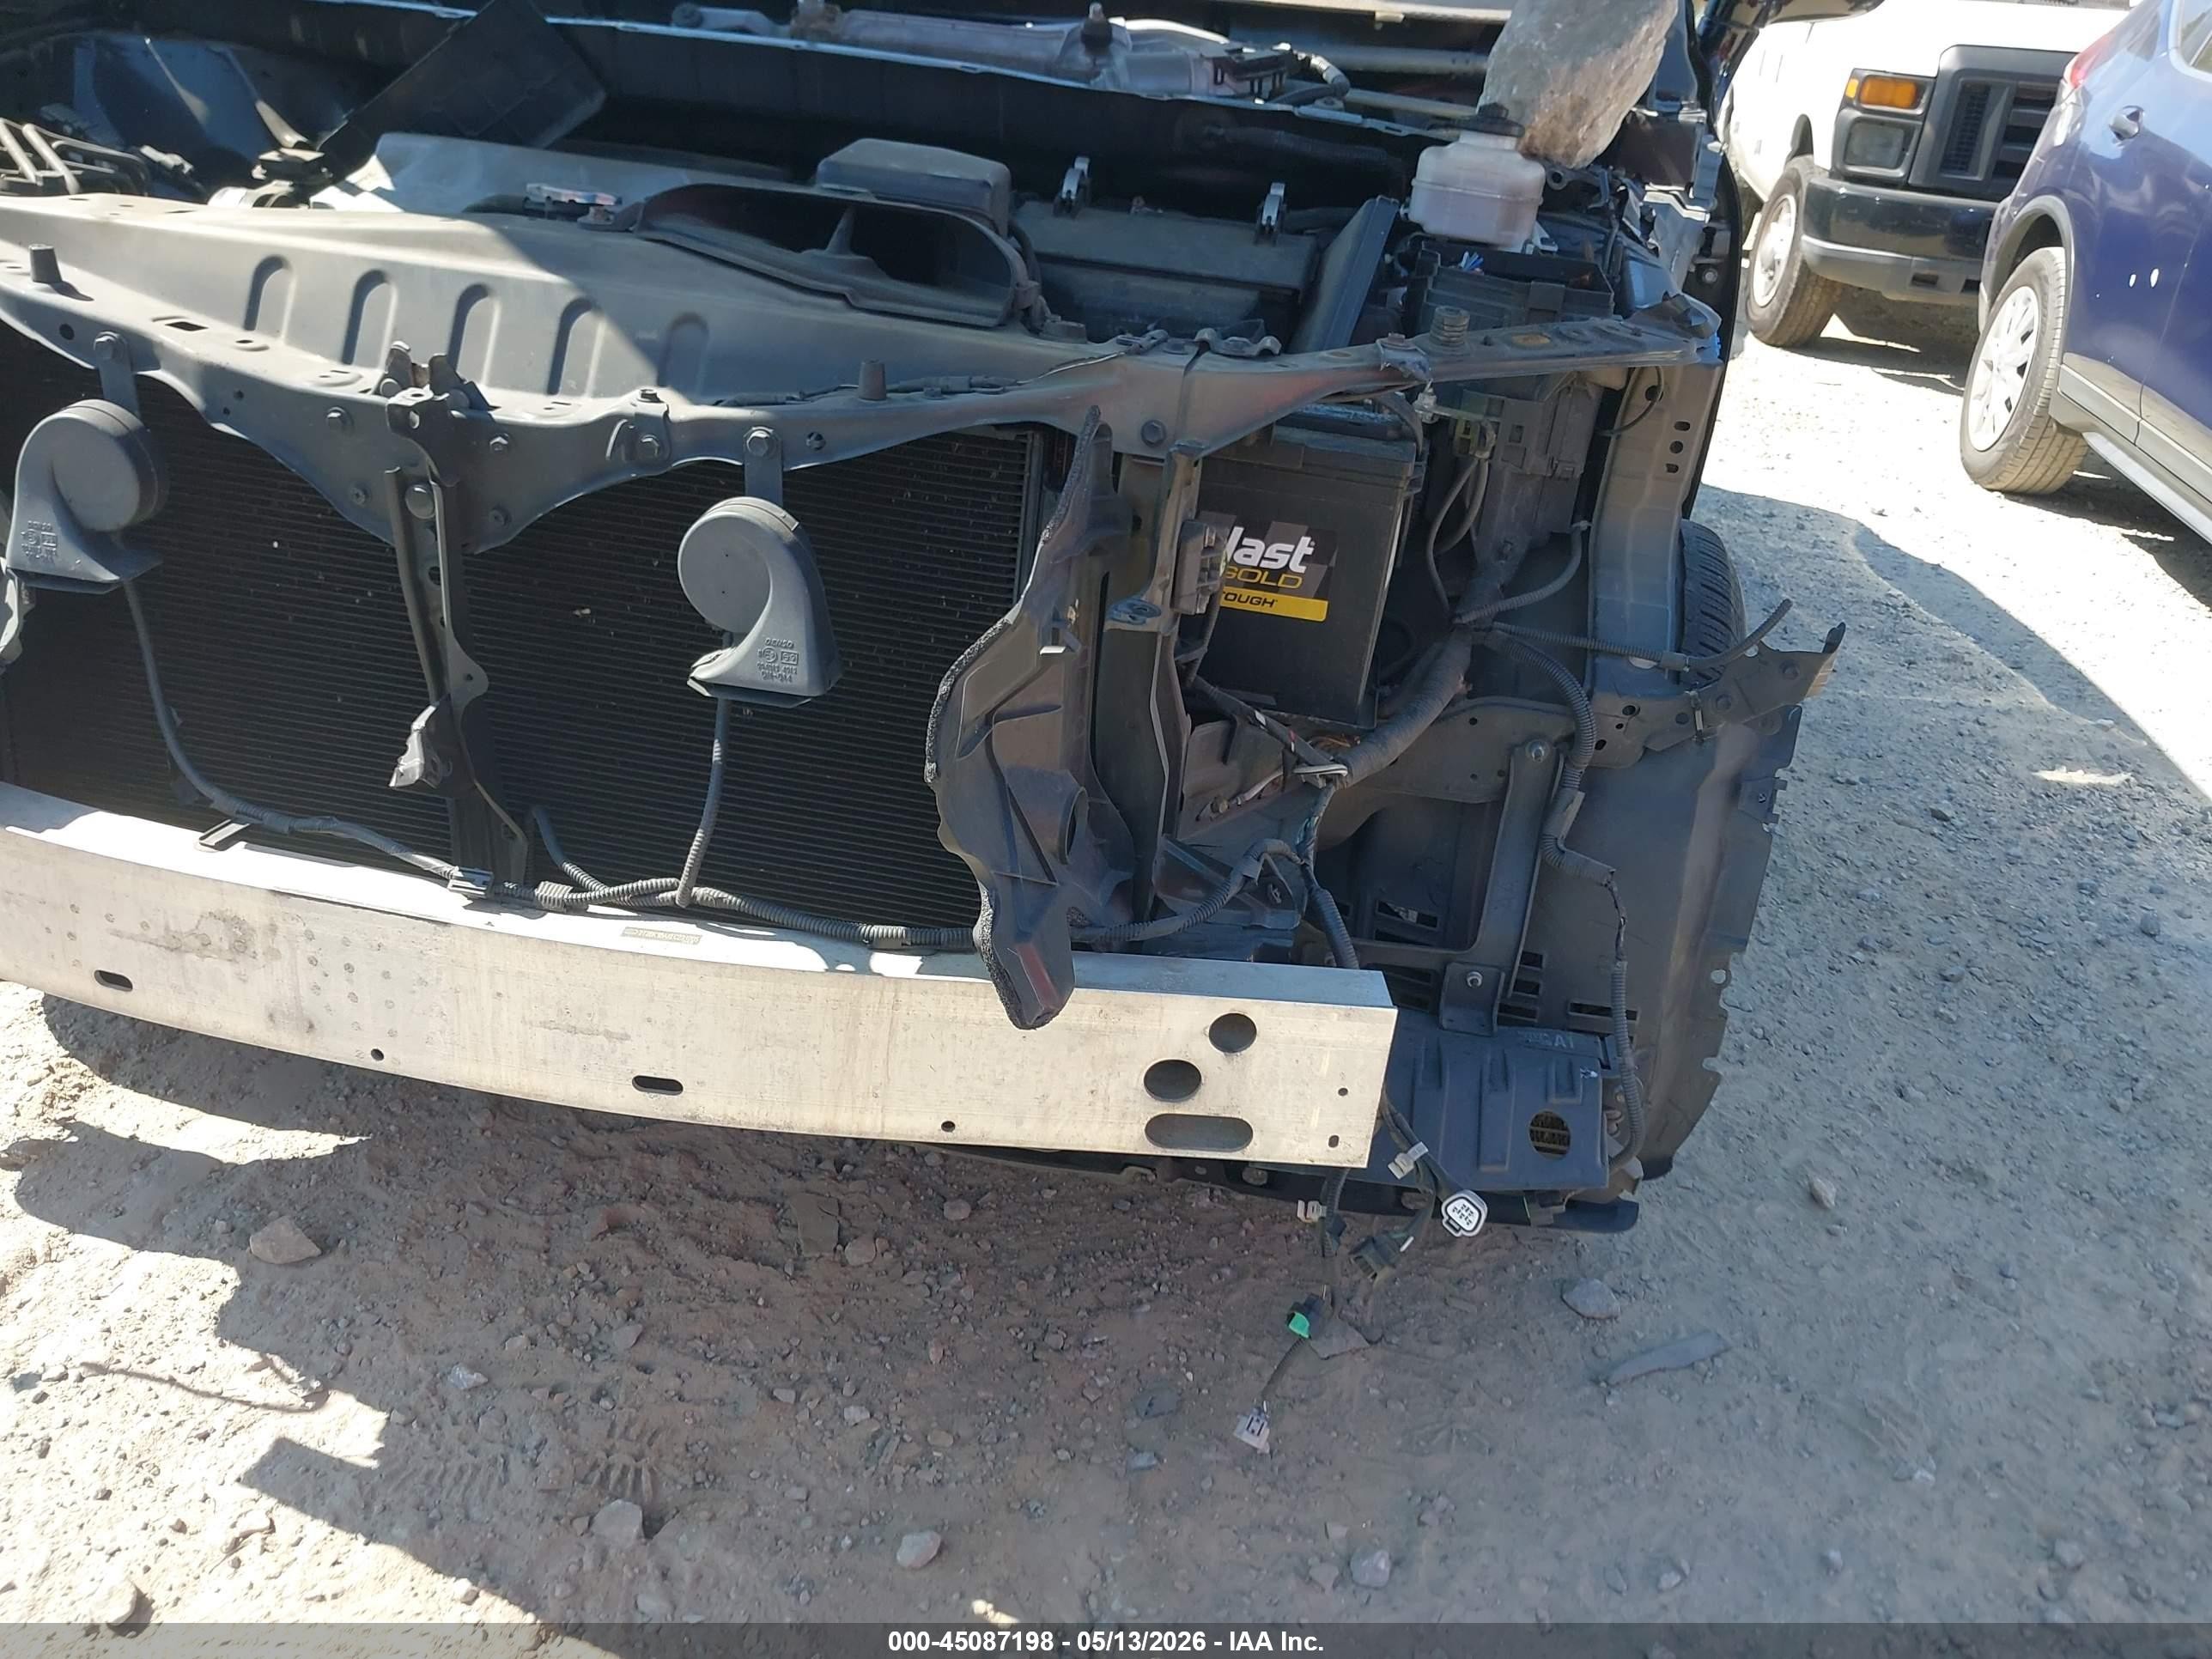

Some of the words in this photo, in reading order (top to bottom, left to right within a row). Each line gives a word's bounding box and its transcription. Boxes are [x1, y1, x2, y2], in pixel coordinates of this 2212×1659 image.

[1224, 566, 1303, 589] GOLD
[1223, 592, 1276, 608] OUGH
[765, 637, 794, 648] DENSO
